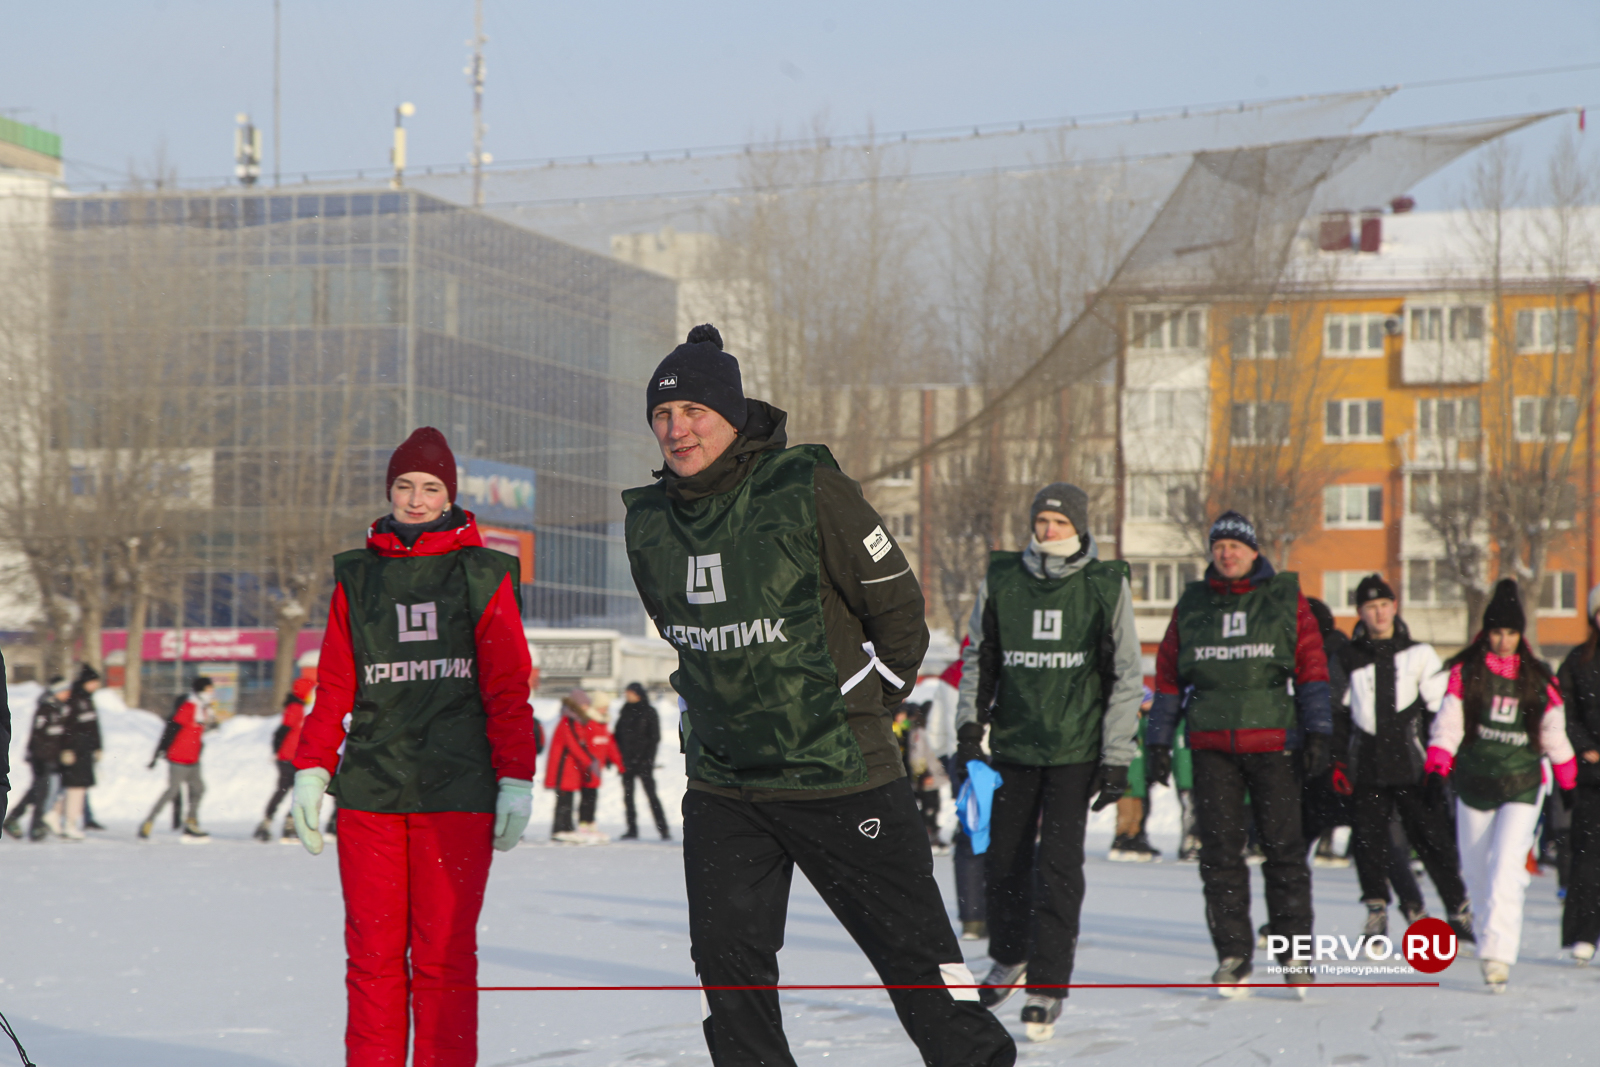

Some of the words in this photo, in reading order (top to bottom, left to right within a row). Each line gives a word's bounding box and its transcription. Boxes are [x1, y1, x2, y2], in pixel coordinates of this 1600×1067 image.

[659, 378, 676, 387] FILA
[1002, 650, 1088, 668] ХРОМПИК
[1194, 643, 1275, 661] ХРОМПИК
[364, 658, 473, 685] ХРОМПИК
